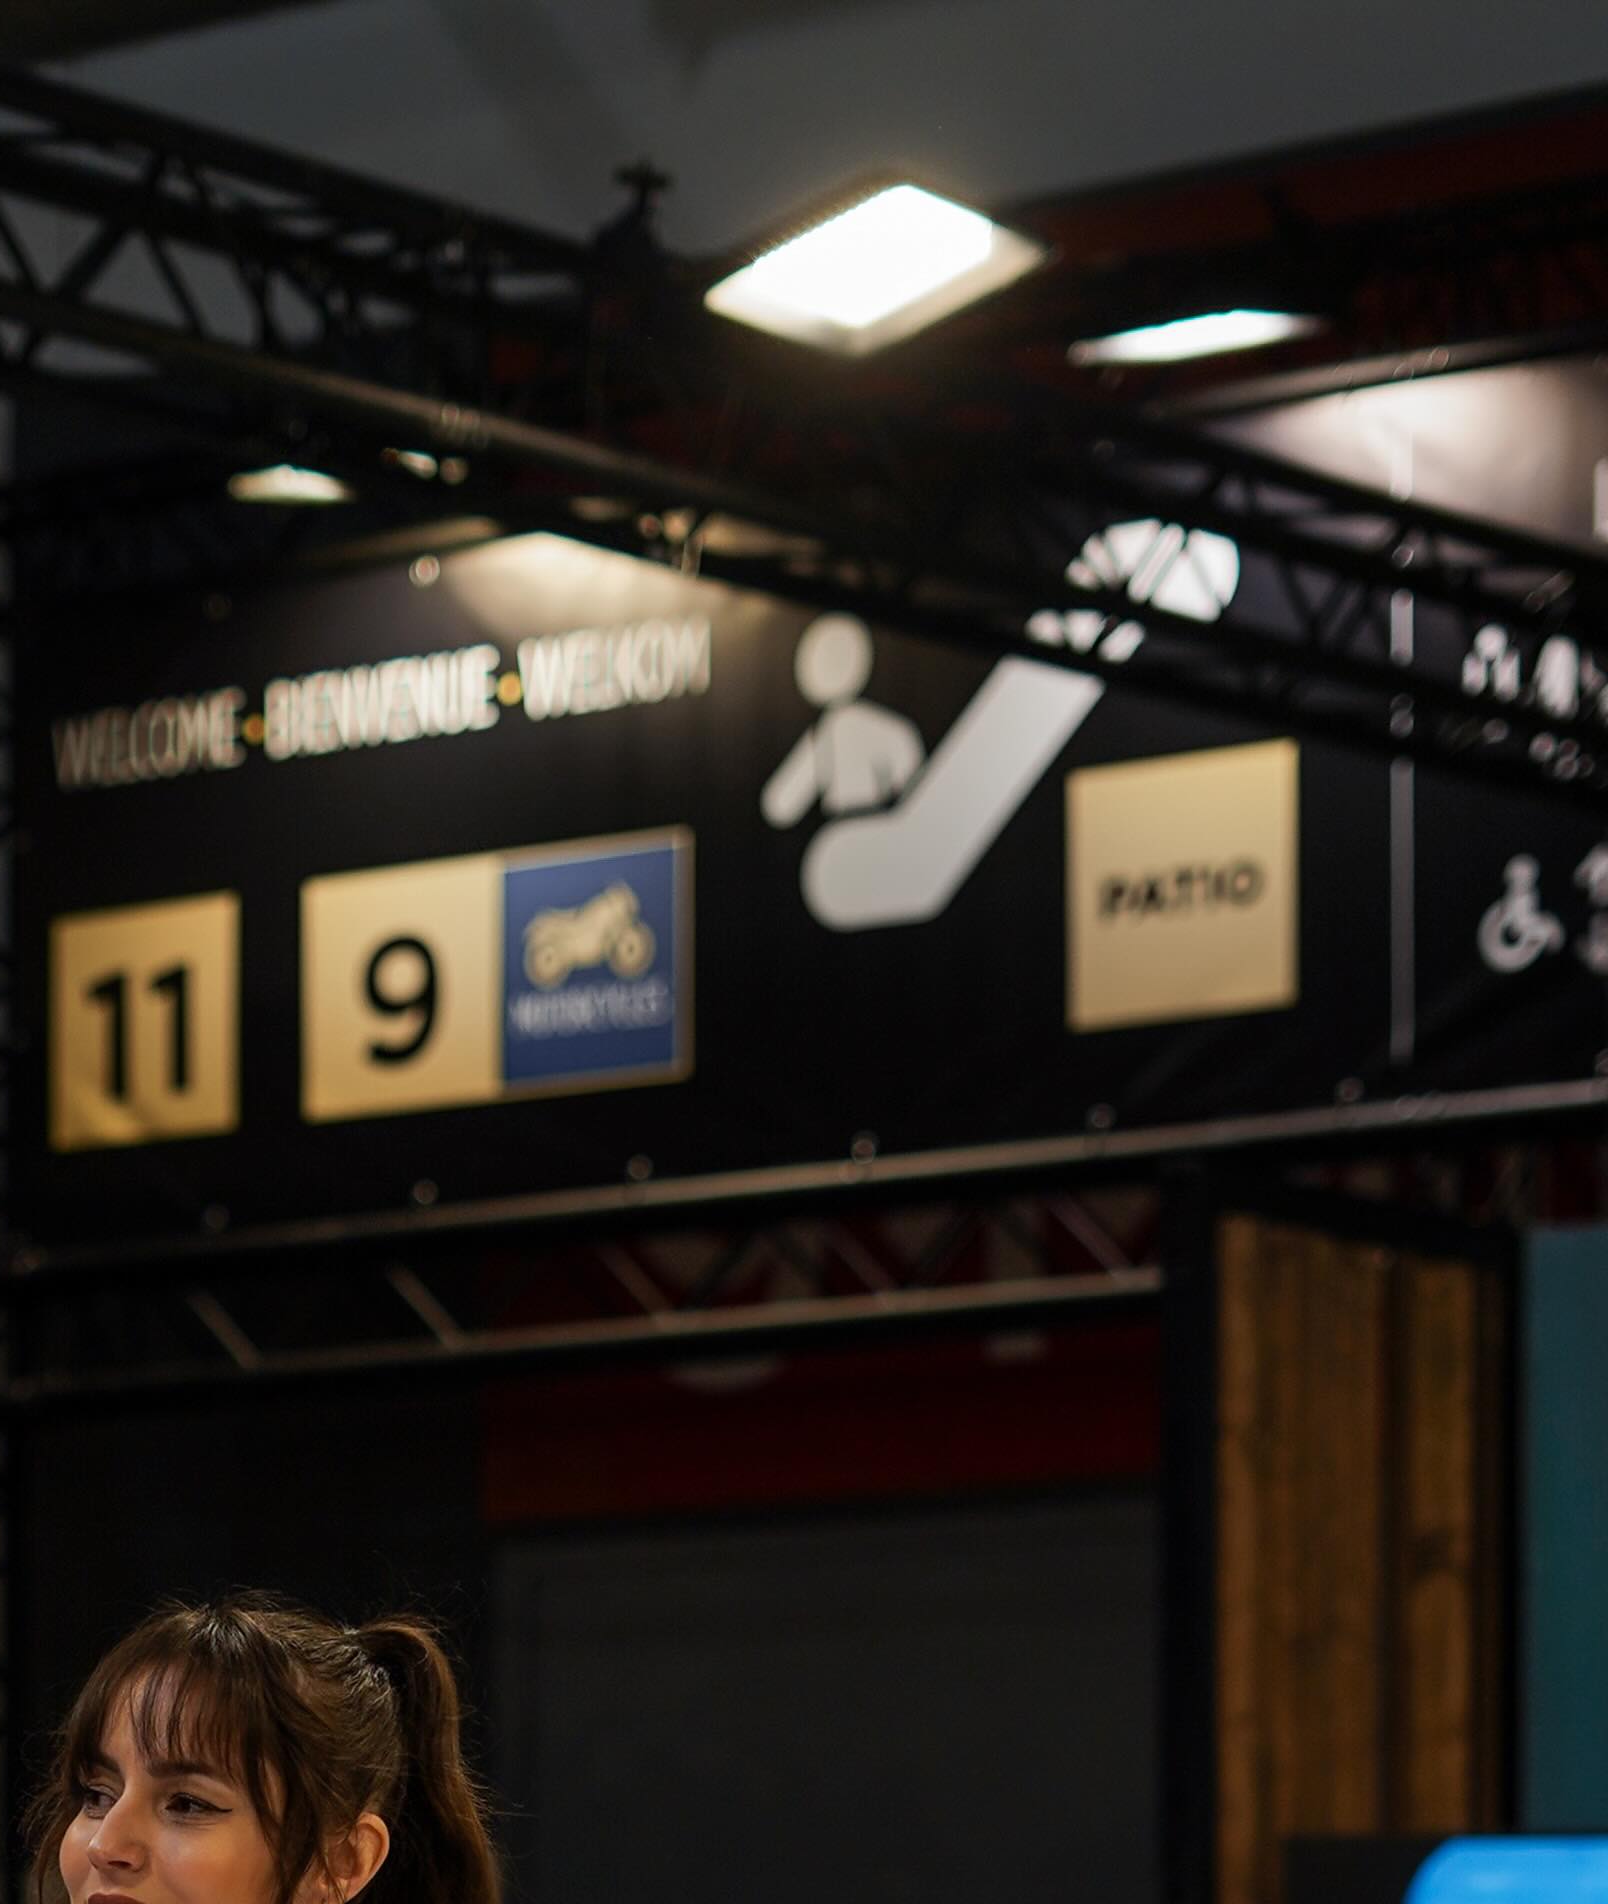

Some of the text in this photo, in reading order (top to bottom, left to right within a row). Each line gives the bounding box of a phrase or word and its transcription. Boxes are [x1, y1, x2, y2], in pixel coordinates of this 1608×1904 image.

[53, 617, 710, 789] WELCOME BIENVENUE WELKOM
[1098, 857, 1266, 922] PATIO
[87, 962, 193, 1104] 11
[362, 936, 441, 1069] 9
